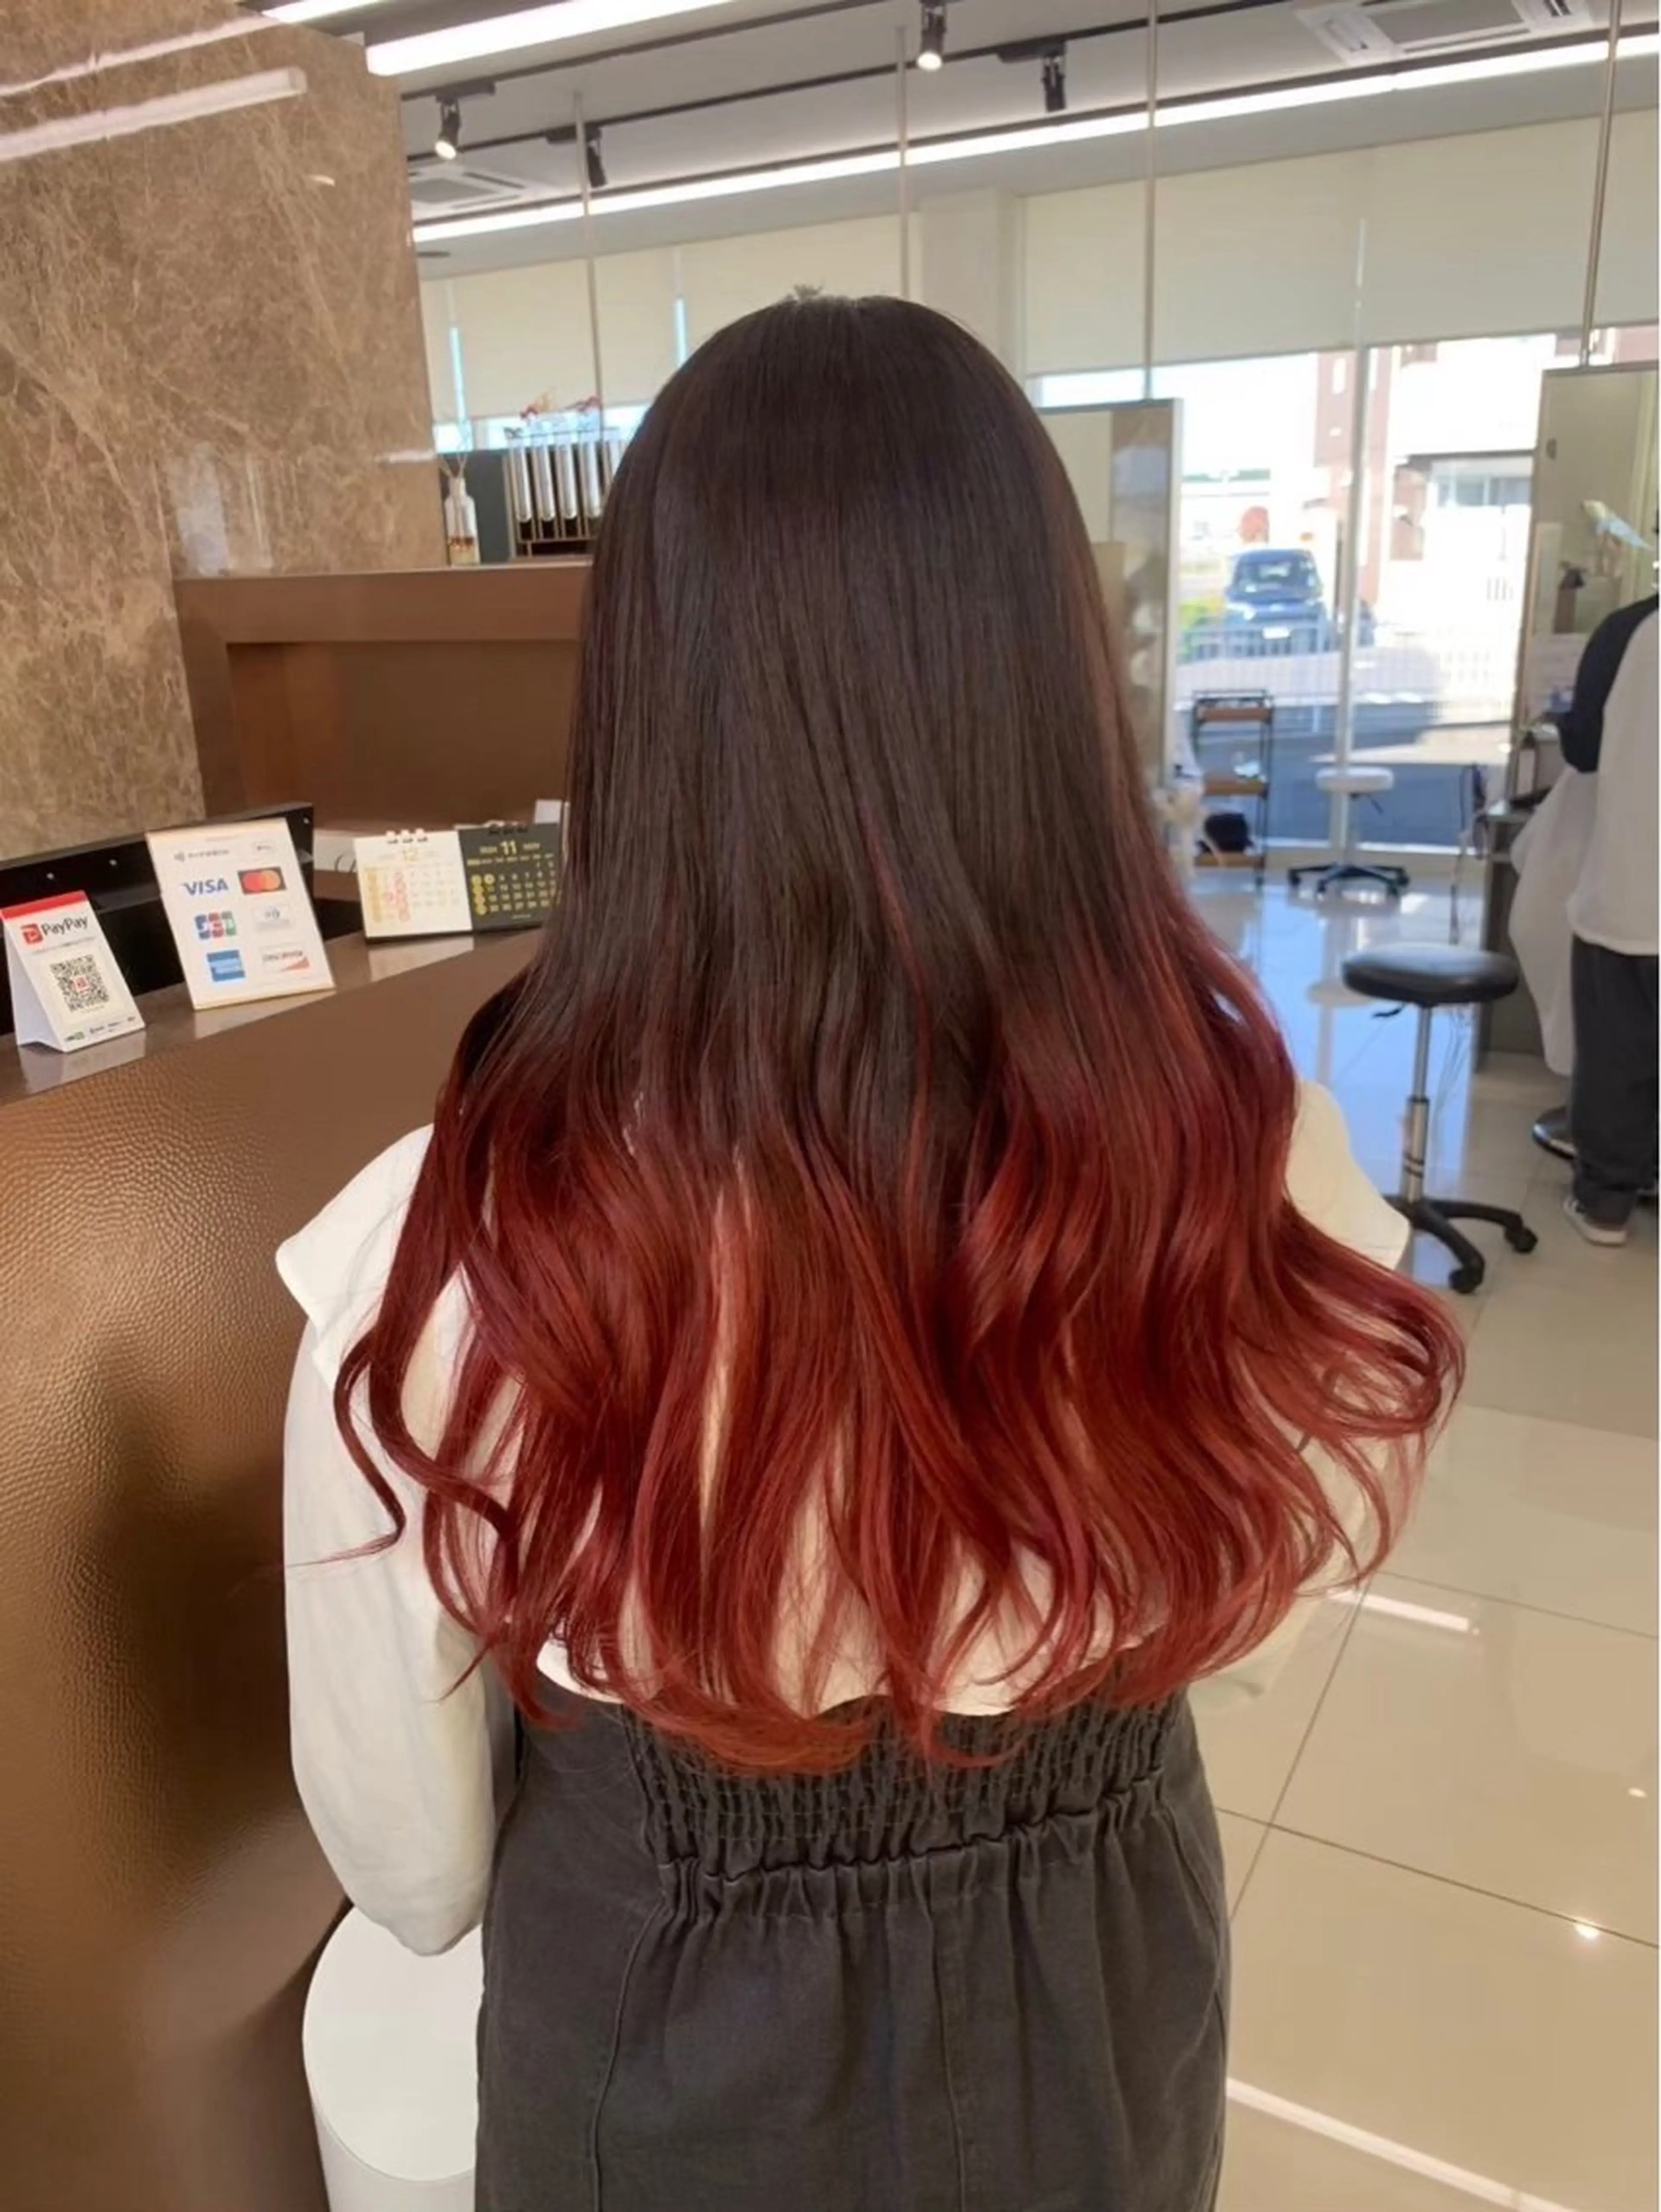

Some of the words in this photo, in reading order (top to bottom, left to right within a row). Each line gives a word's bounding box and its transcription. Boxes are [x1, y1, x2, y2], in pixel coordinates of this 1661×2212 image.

[500, 839, 517, 855] 11
[182, 877, 229, 896] VISA
[41, 915, 88, 936] PayPay
